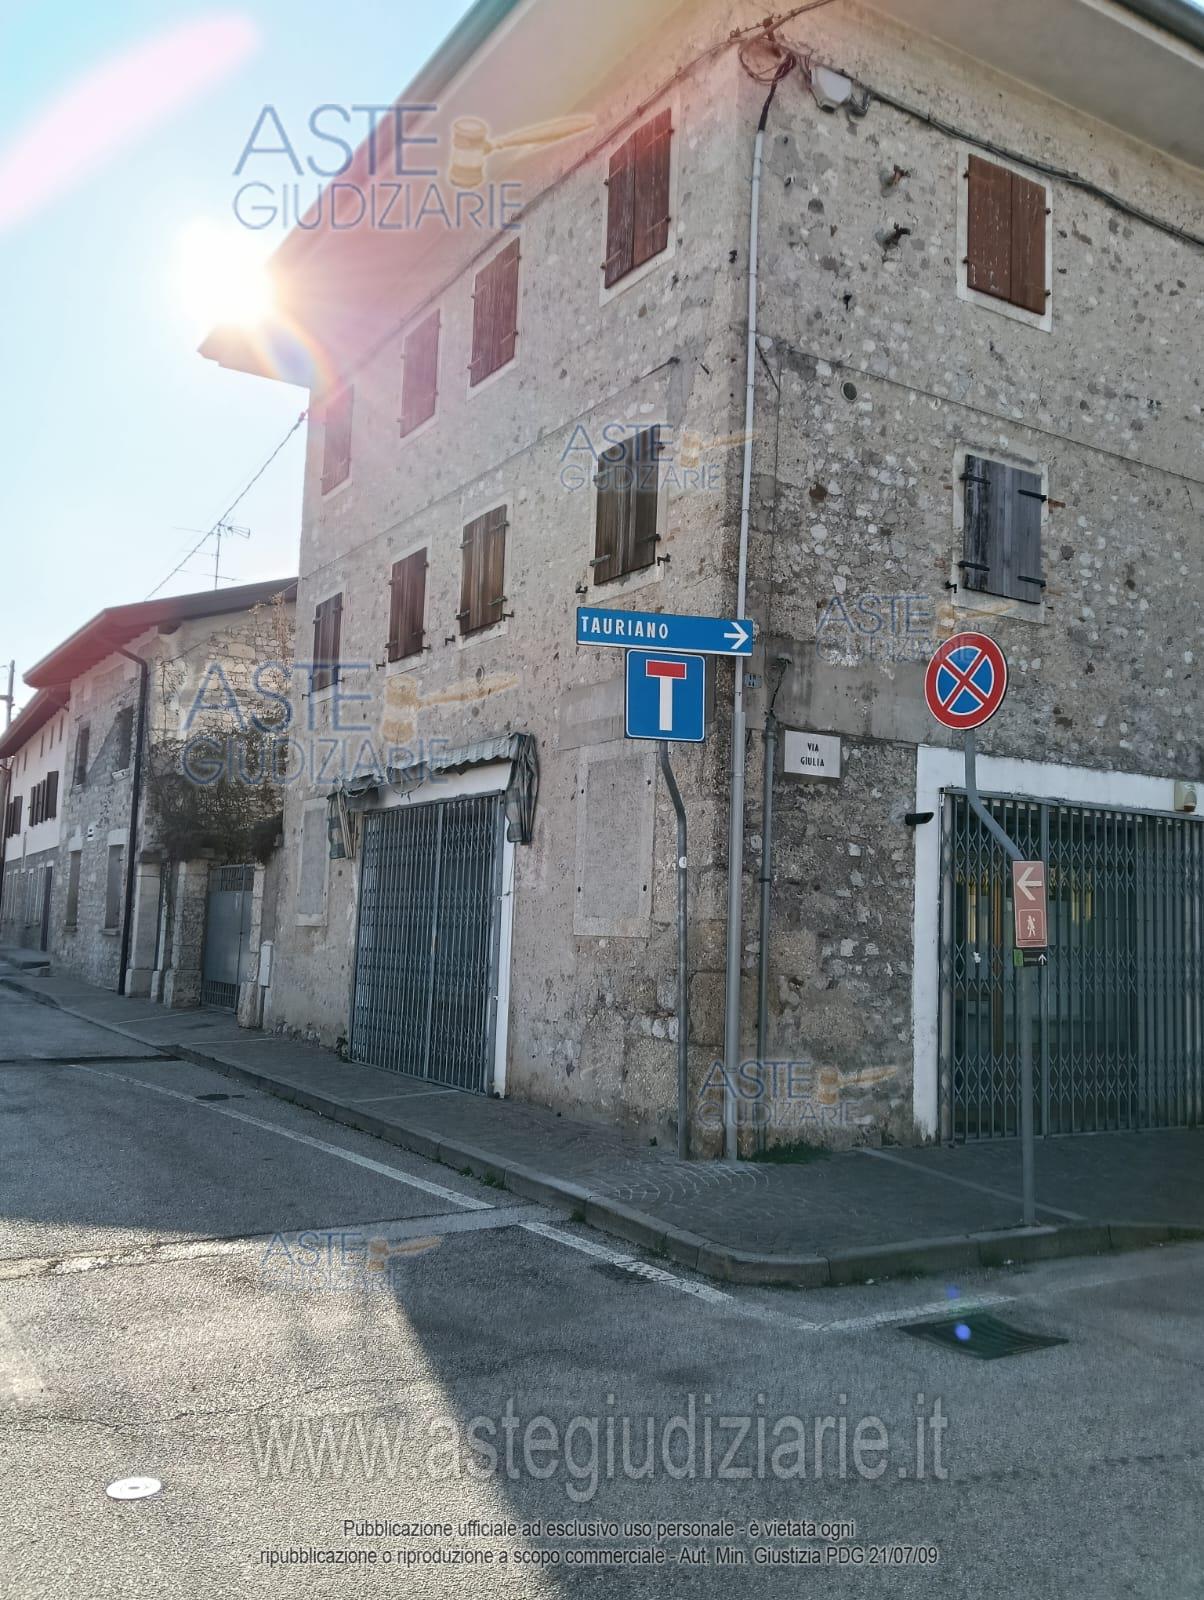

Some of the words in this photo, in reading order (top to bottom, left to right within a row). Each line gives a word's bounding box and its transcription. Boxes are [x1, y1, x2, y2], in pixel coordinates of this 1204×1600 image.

[580, 615, 669, 640] TAURIANO
[807, 742, 819, 752] VIA
[800, 756, 825, 768] GIULIA
